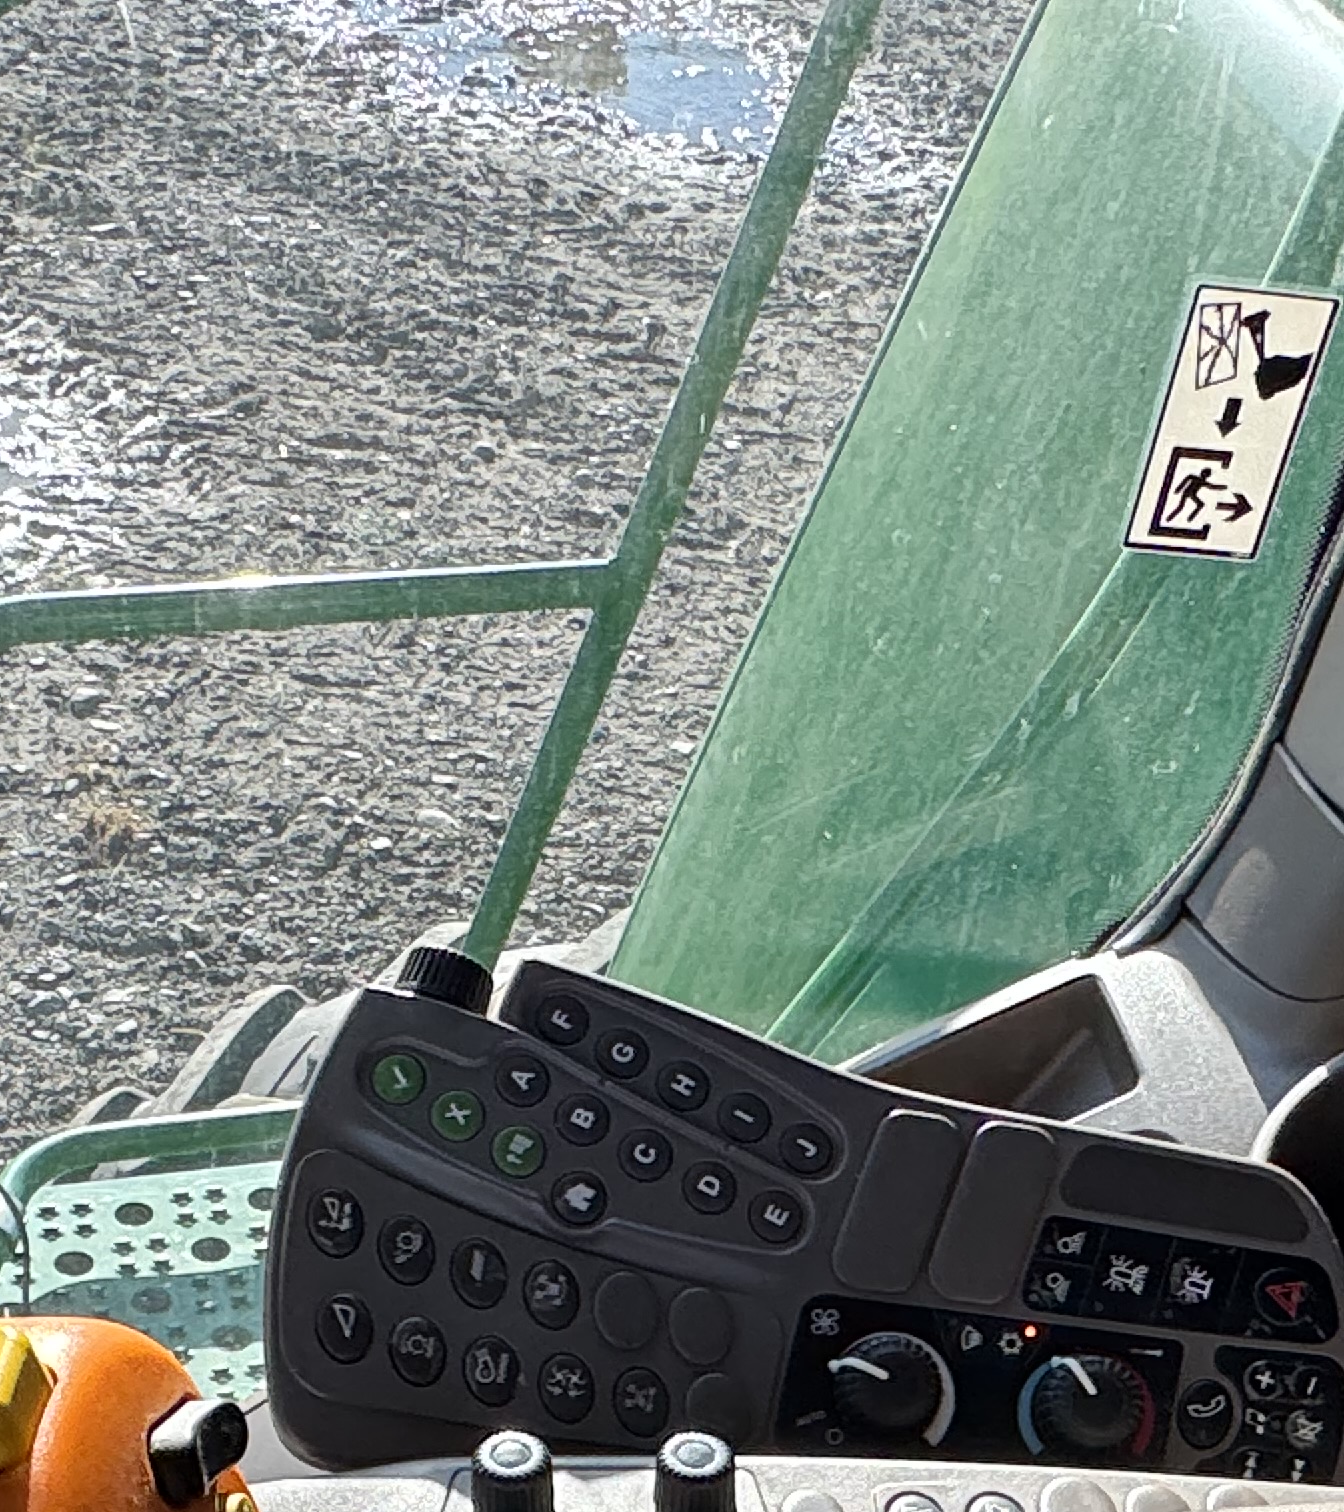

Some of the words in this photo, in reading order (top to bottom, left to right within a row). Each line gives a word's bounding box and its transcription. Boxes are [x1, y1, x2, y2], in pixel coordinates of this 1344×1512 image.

[550, 1008, 573, 1031] F
[611, 1042, 635, 1064] G
[510, 1070, 536, 1092] A
[670, 1073, 697, 1097] H
[570, 1108, 596, 1130] B
[633, 1143, 657, 1164] C
[796, 1138, 818, 1158] J
[696, 1175, 721, 1198] D
[763, 1204, 791, 1227] E
